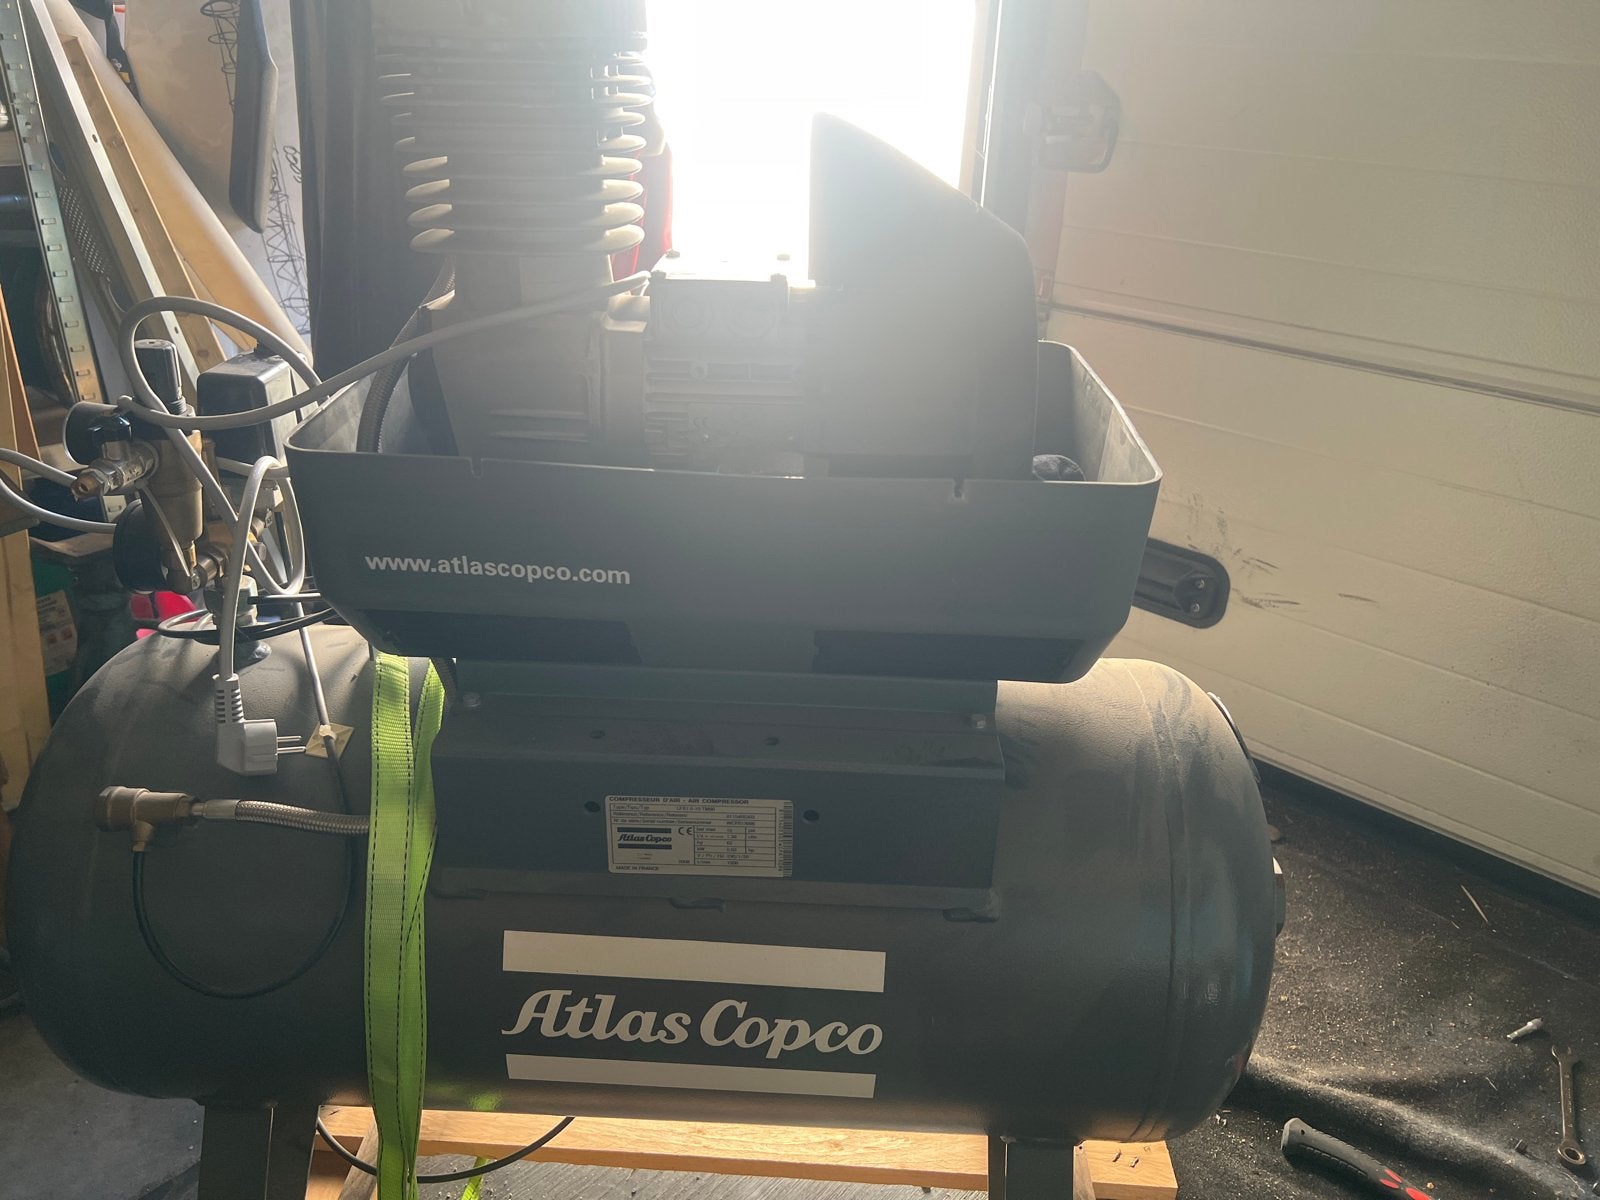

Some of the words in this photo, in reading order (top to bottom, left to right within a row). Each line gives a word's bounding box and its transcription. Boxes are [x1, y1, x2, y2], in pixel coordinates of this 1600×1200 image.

[365, 555, 630, 584] www.atlascopco.com
[617, 833, 645, 842] Atlas
[646, 834, 672, 844] Copco
[501, 989, 692, 1044] Atlas
[700, 999, 883, 1059] Copco
